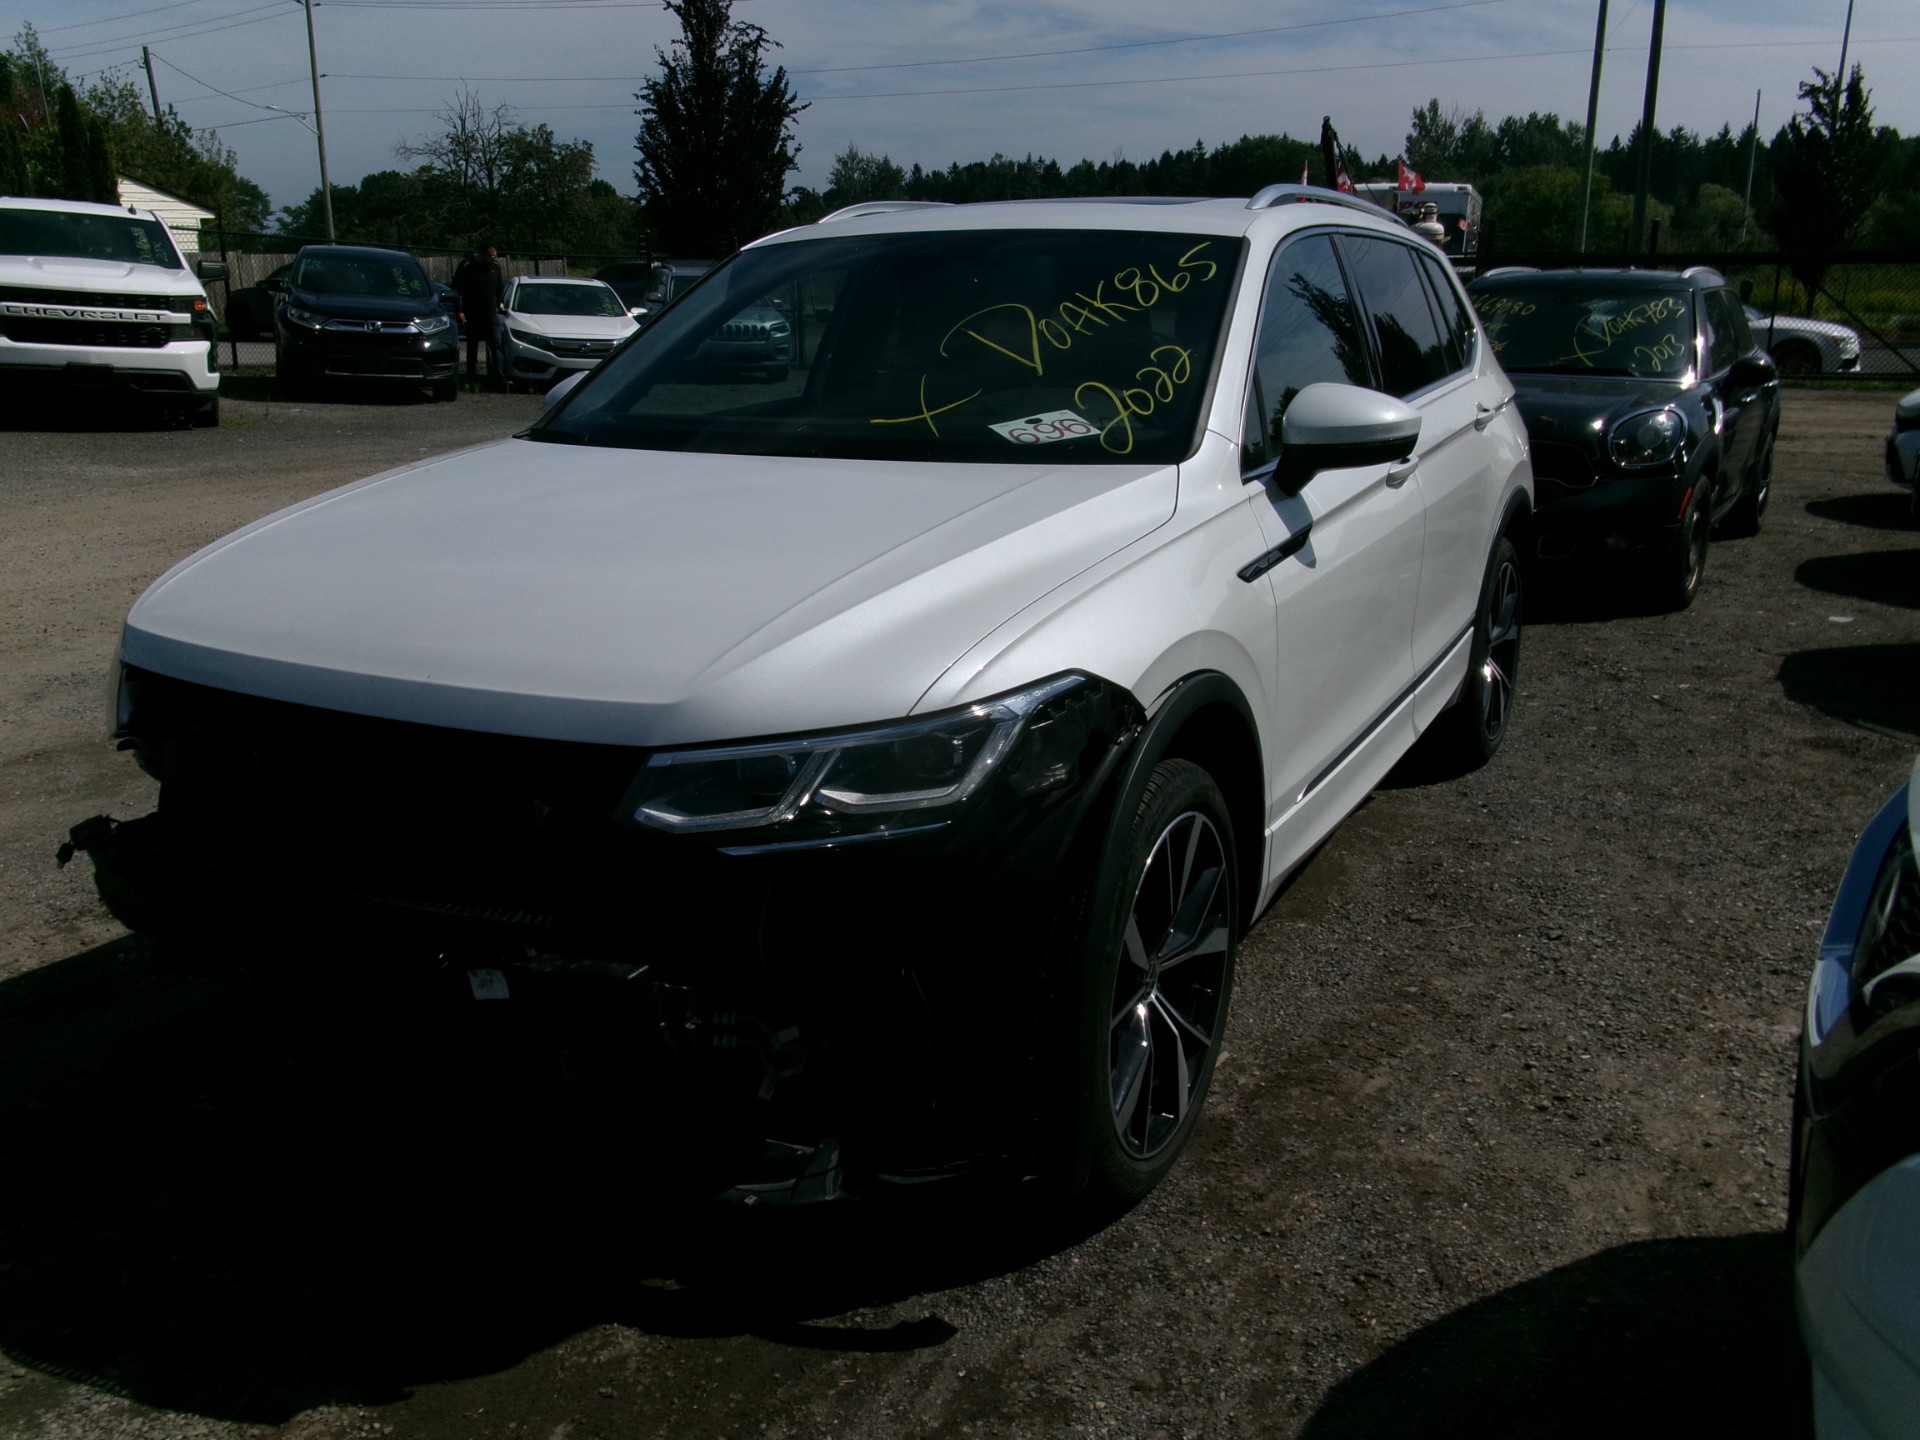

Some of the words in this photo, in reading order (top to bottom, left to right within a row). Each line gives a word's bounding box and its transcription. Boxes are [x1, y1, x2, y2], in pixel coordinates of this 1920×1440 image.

[5, 305, 168, 321] CHEVROLET
[1633, 333, 1685, 372] 2013
[1074, 344, 1192, 455] 2022
